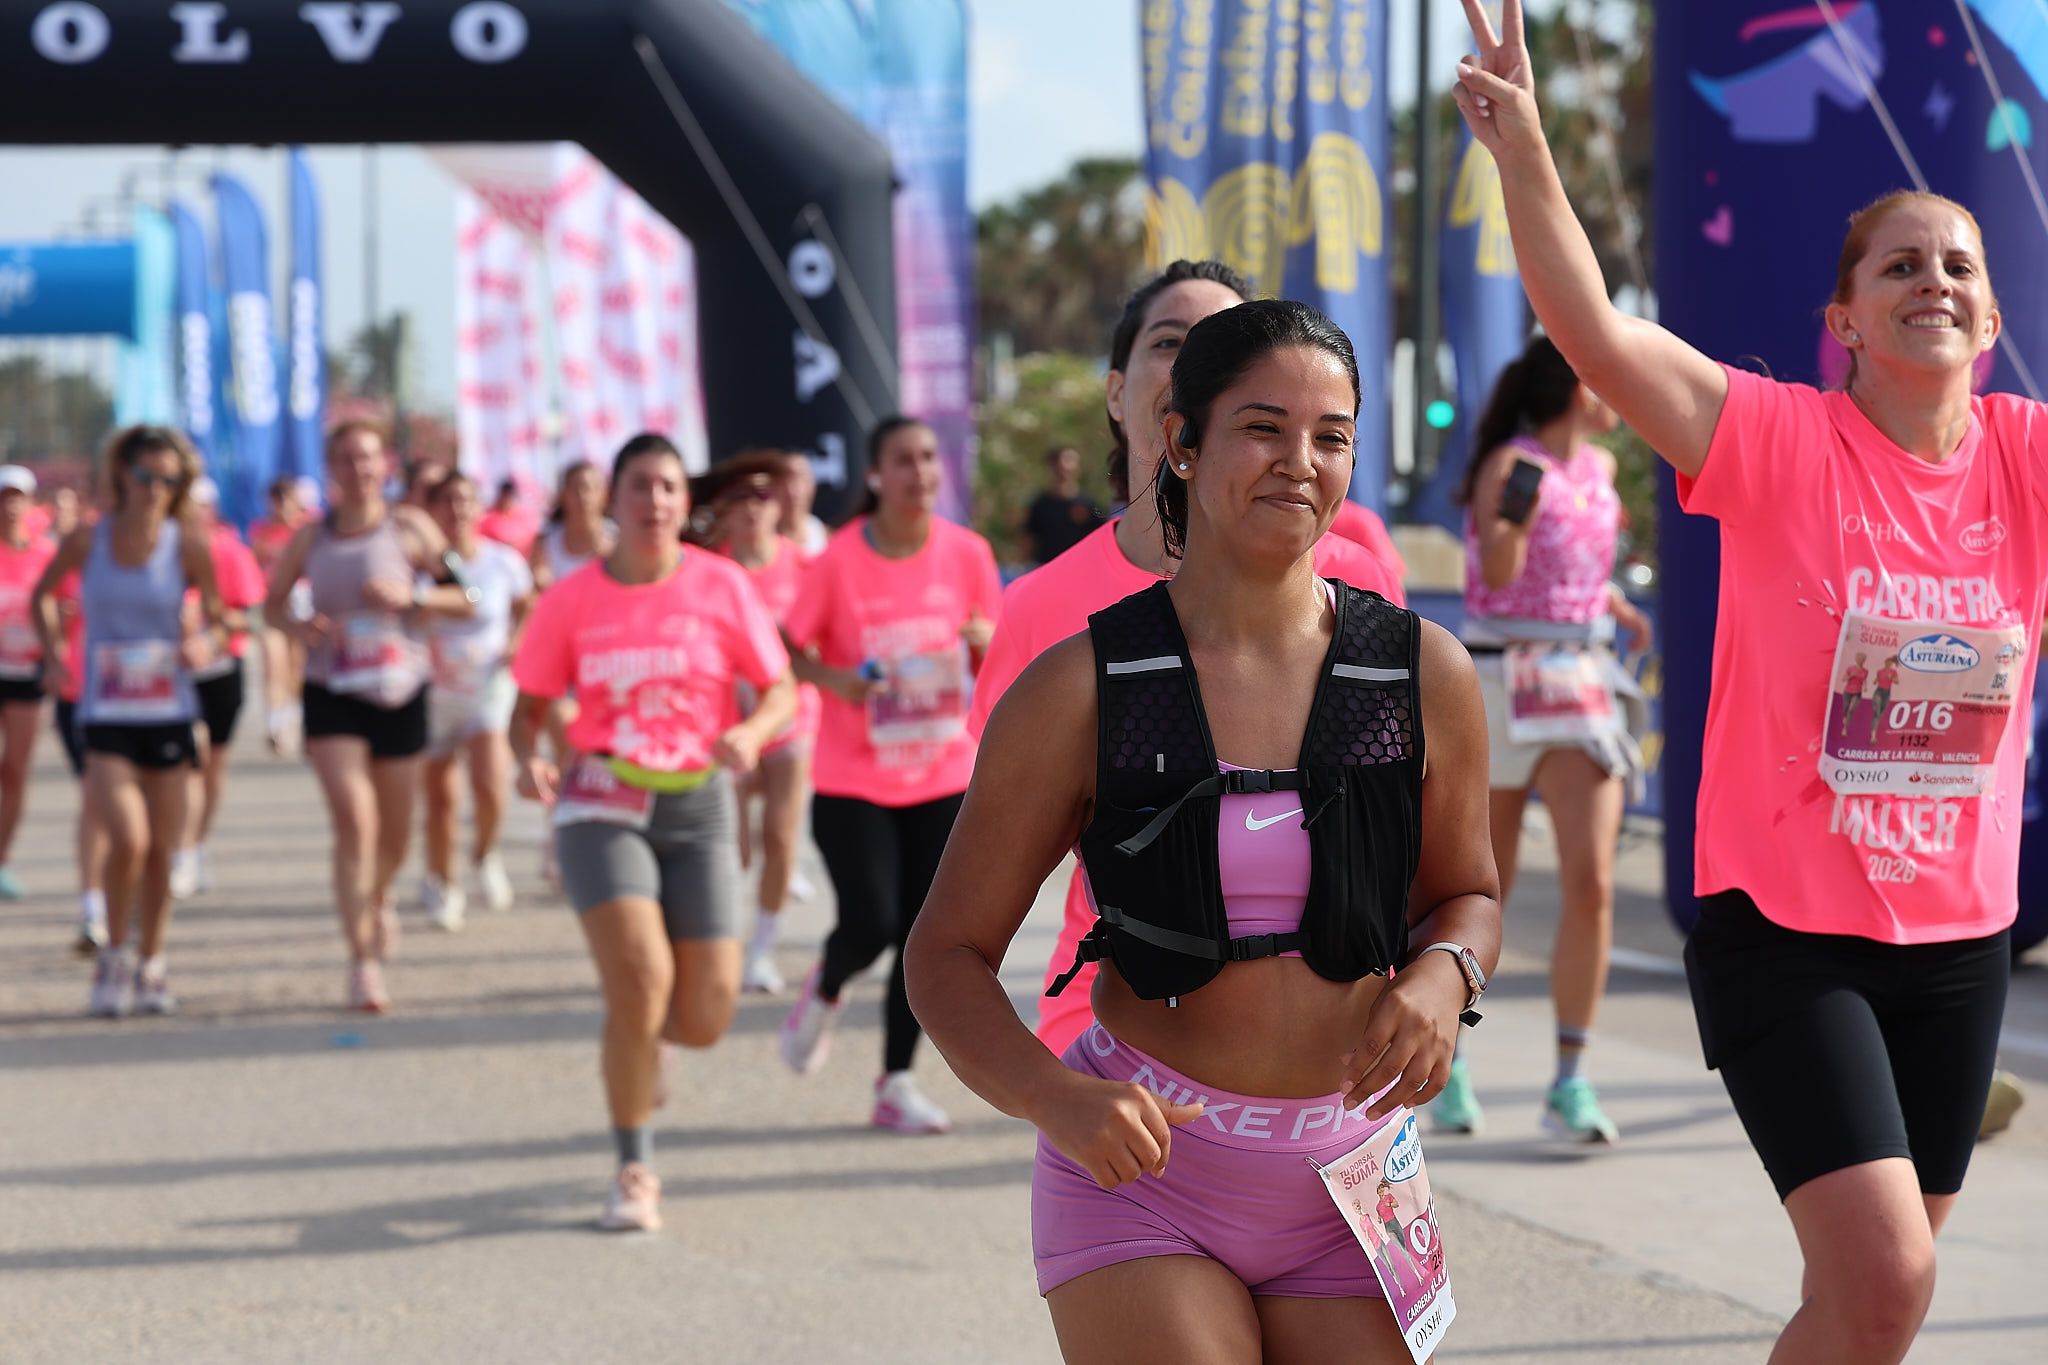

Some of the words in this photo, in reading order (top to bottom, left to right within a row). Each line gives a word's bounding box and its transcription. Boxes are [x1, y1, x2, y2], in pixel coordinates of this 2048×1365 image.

[1848, 567, 2006, 622] CARRERA
[1860, 632, 1898, 648] SUMA
[1904, 647, 1973, 667] ASTURIANA
[1889, 700, 1954, 730] 016
[1837, 747, 1879, 760] CARRERA
[1880, 749, 1891, 760] DE
[1892, 750, 1902, 760] LA
[1904, 750, 1934, 761] MUJER
[1942, 752, 1980, 763] VALENCIA
[1900, 734, 1930, 747] 1132
[1835, 768, 1889, 783] OYSHO
[1923, 773, 1975, 784] Santander
[1829, 795, 1961, 852] MUJER
[1867, 854, 1917, 884] 2026
[1290, 1086, 1385, 1140] PR
[1339, 1168, 1350, 1179] TU
[1349, 1151, 1375, 1173] DORSAL
[1343, 1160, 1379, 1191] SUMA
[1407, 1290, 1433, 1321] CARRERA
